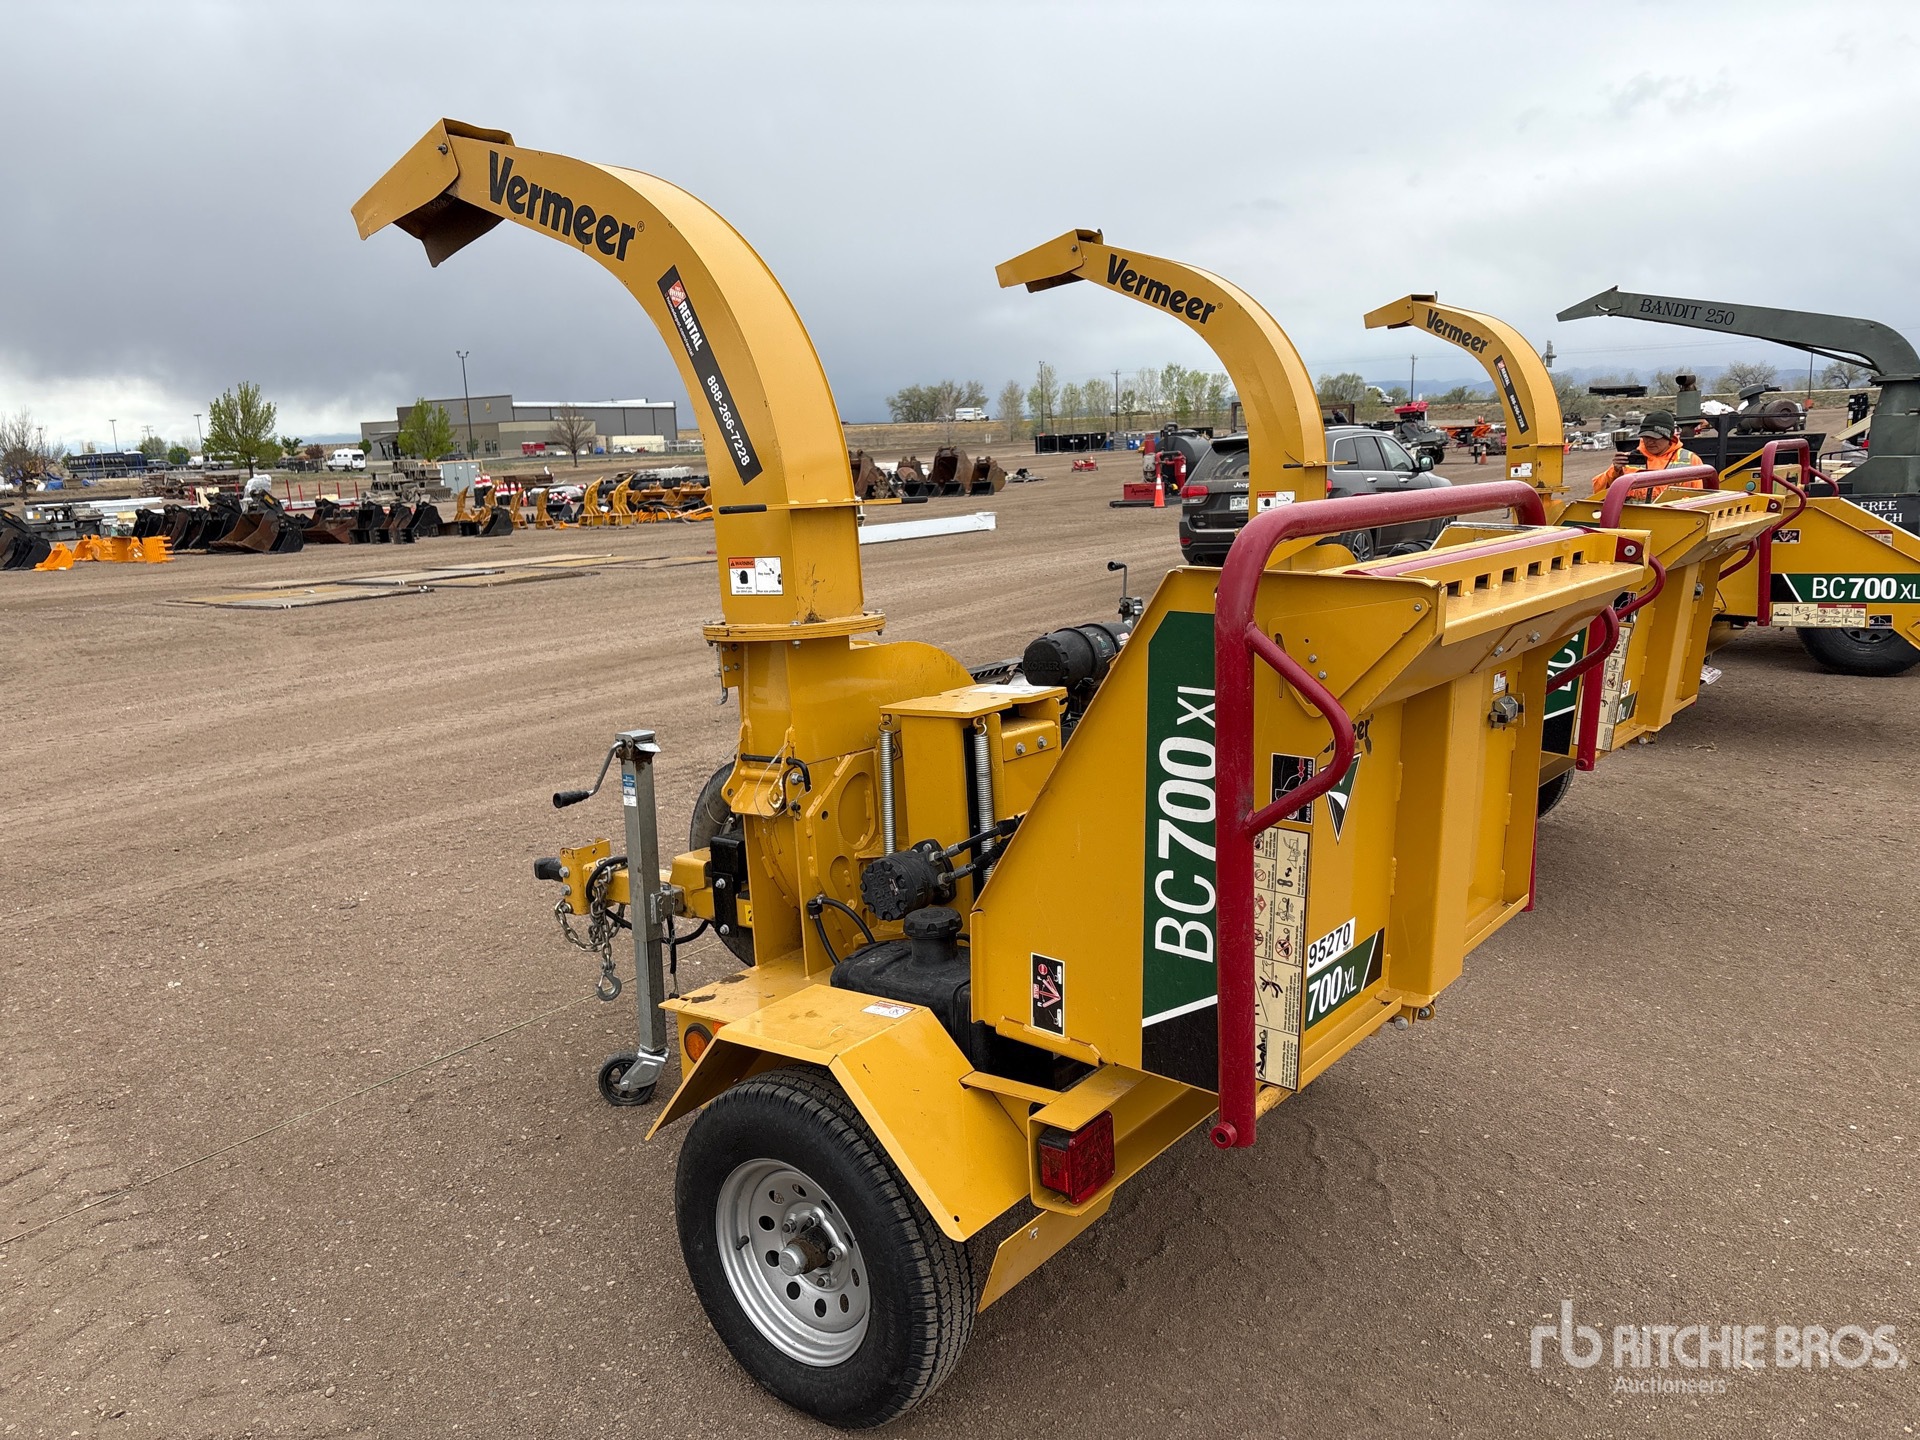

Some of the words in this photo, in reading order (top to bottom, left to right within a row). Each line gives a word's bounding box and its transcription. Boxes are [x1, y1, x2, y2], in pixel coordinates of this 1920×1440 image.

[678, 300, 703, 352] RENTAL
[1640, 298, 1702, 320] BANDIT
[1704, 308, 1735, 326] 250
[707, 374, 750, 467] 888-266-7228
[1860, 500, 1898, 511] FREE
[1308, 922, 1351, 969] 95270
